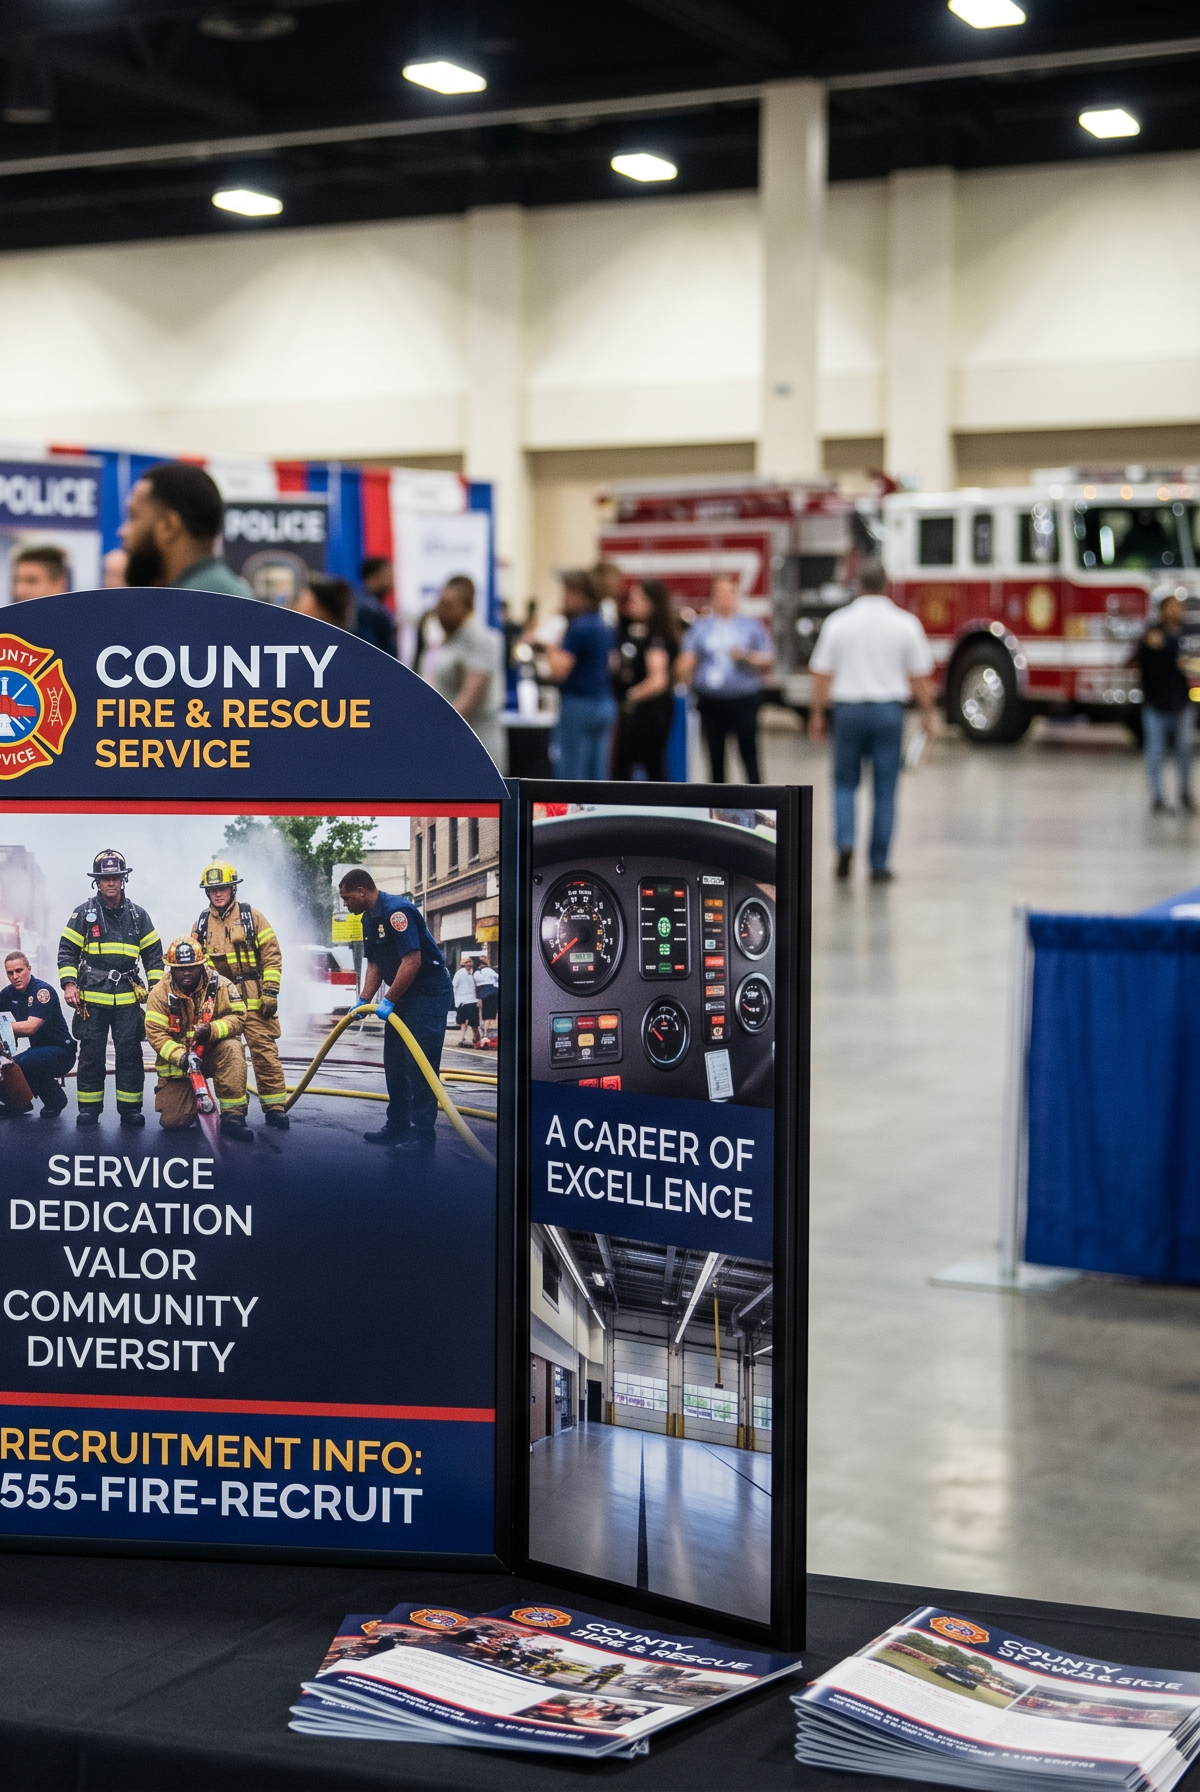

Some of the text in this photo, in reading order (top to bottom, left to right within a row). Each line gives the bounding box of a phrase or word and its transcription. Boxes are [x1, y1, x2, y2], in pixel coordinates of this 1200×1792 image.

[224, 509, 326, 543] POLICE
[95, 644, 339, 689] COUNTY
[96, 698, 371, 729] FIRE & RESCUE
[94, 738, 250, 769] SERVICE
[545, 1114, 755, 1172] A CAREER OF
[47, 1154, 215, 1190] SERVICE
[547, 1160, 753, 1223] EXCELLENCE
[10, 1198, 252, 1236] DEDICATION
[63, 1245, 197, 1281] VALOR
[3, 1289, 259, 1328] COMMUNITY
[27, 1335, 236, 1373] DIVERSITY
[0, 1427, 422, 1475] RECRUITMENT INFO:
[0, 1472, 423, 1525] 555-FIRE-RECRUIT
[586, 1623, 694, 1651] COUNTY
[649, 1649, 753, 1670] RESCUE
[1003, 1640, 1122, 1674] COUNTY
